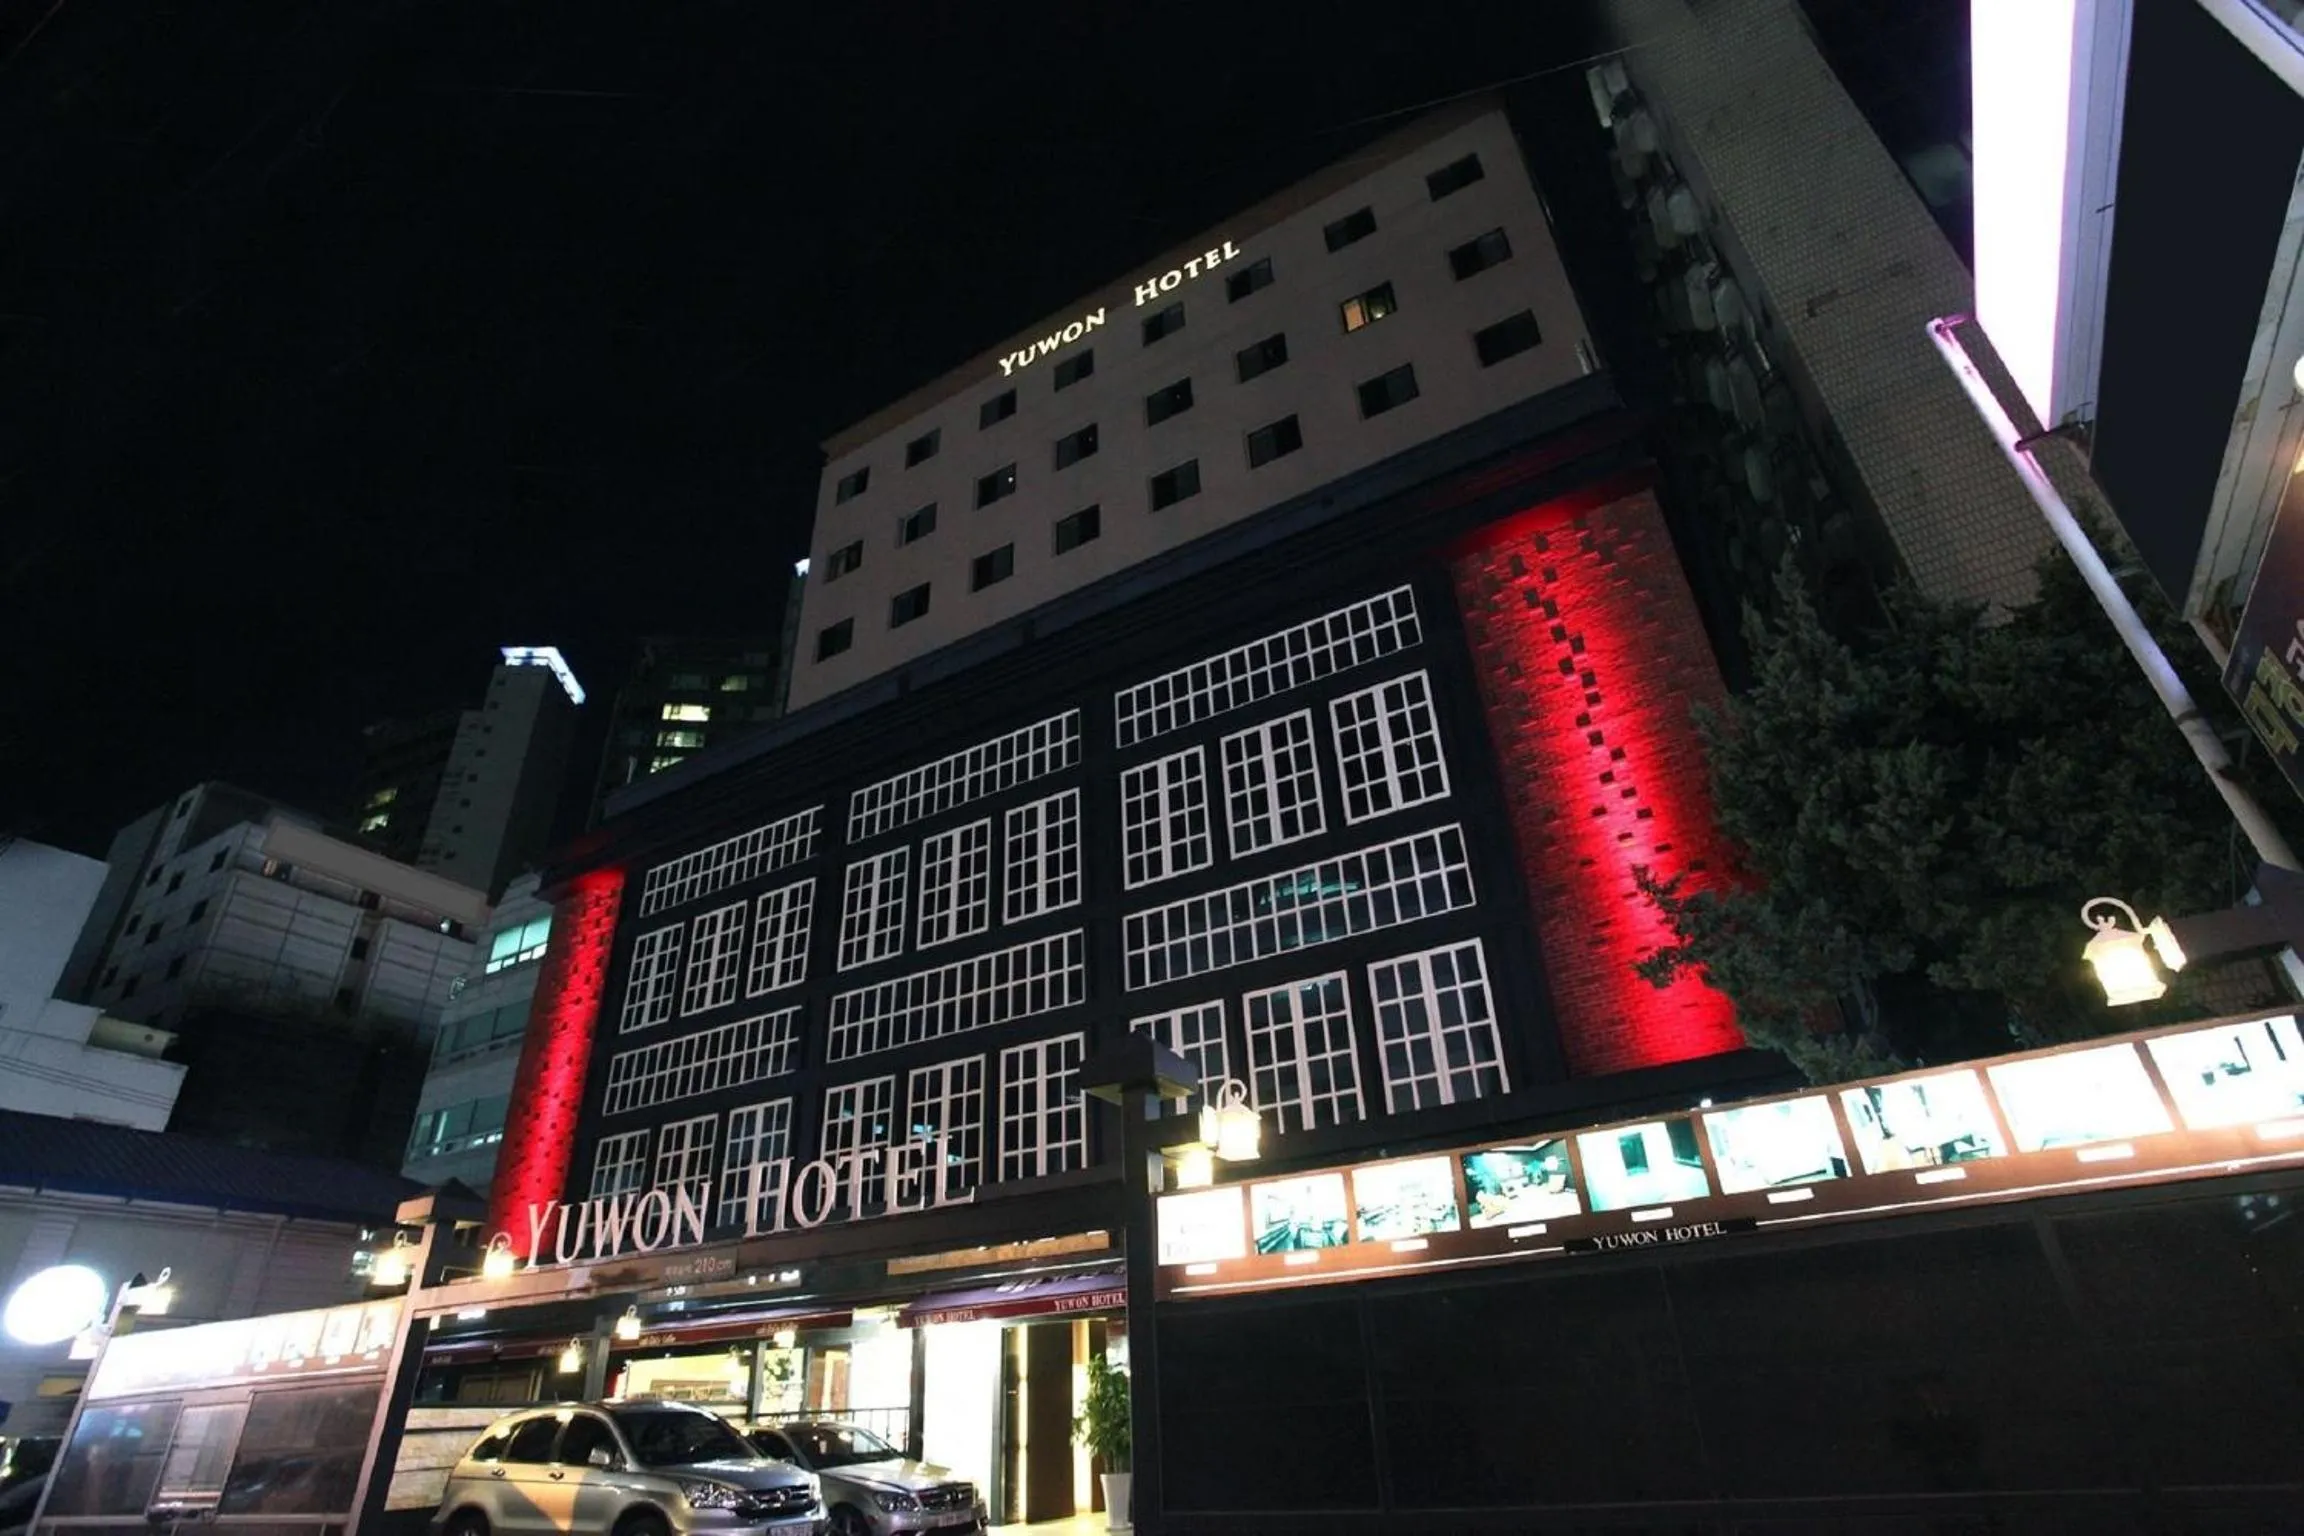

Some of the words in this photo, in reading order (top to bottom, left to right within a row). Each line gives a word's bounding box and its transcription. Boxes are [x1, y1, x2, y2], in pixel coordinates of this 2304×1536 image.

[998, 307, 1106, 378] YUWON
[1134, 241, 1240, 306] HOTEL
[524, 1182, 712, 1273] YUWON
[743, 1135, 976, 1238] HOTEL
[1593, 1230, 1659, 1250] YUWON
[1665, 1221, 1728, 1242] HOTEL
[1091, 1292, 1125, 1306] HOTEL
